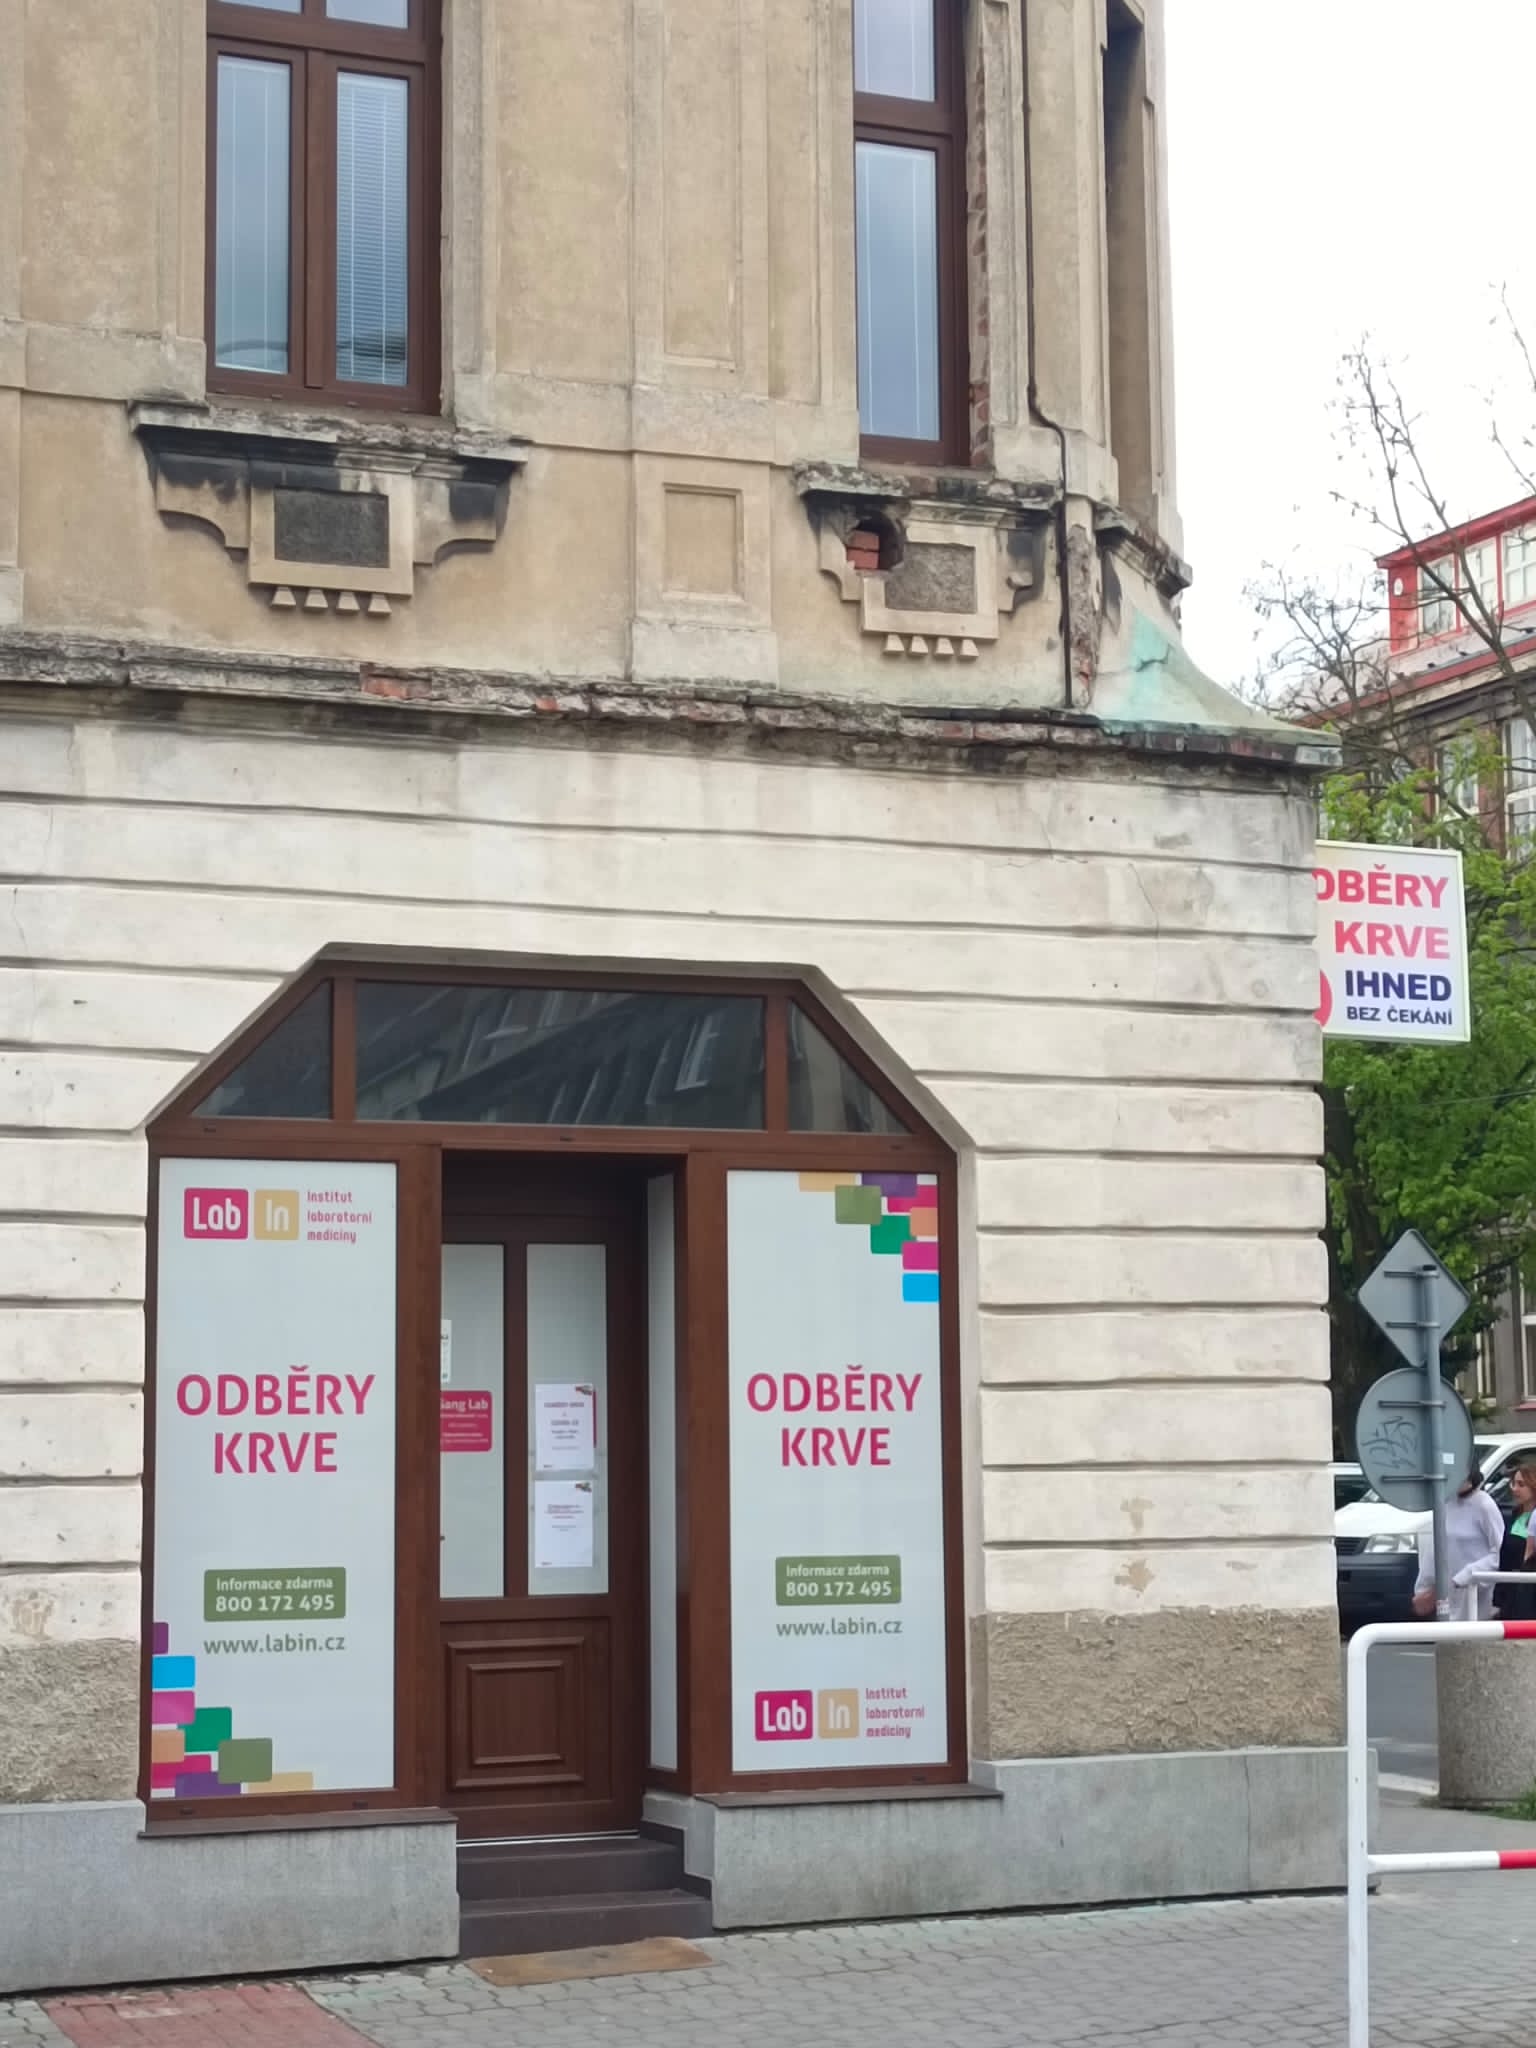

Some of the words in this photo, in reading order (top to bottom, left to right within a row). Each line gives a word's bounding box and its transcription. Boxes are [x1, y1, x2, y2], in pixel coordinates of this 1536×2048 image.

[1335, 920, 1450, 960] KRVE
[1345, 970, 1452, 1002] IHNED
[1346, 1006, 1380, 1022] BEZ
[1387, 1004, 1452, 1025] ČEKÁNÍ
[307, 1190, 353, 1203] Institut
[192, 1197, 241, 1231] Lab
[265, 1199, 290, 1232] In
[176, 1365, 375, 1416] ODBĚRY
[746, 1365, 922, 1412] ODBĚRY
[214, 1431, 338, 1474] KRVE
[781, 1427, 891, 1467] KRVE
[785, 1563, 845, 1578] Informace
[847, 1563, 890, 1577] zdarma
[216, 1577, 283, 1591] Informace
[285, 1576, 334, 1591] zdarma
[785, 1581, 819, 1597] 800
[824, 1581, 855, 1597] 172
[860, 1580, 893, 1597] 495
[215, 1595, 252, 1613] 800
[259, 1595, 293, 1612] 172
[299, 1594, 335, 1611] 495
[776, 1617, 903, 1637] www.labin.cz
[203, 1633, 345, 1655] www.labin.cz
[865, 1687, 907, 1700] Institut
[762, 1699, 807, 1733] Lab
[828, 1698, 850, 1729] In
